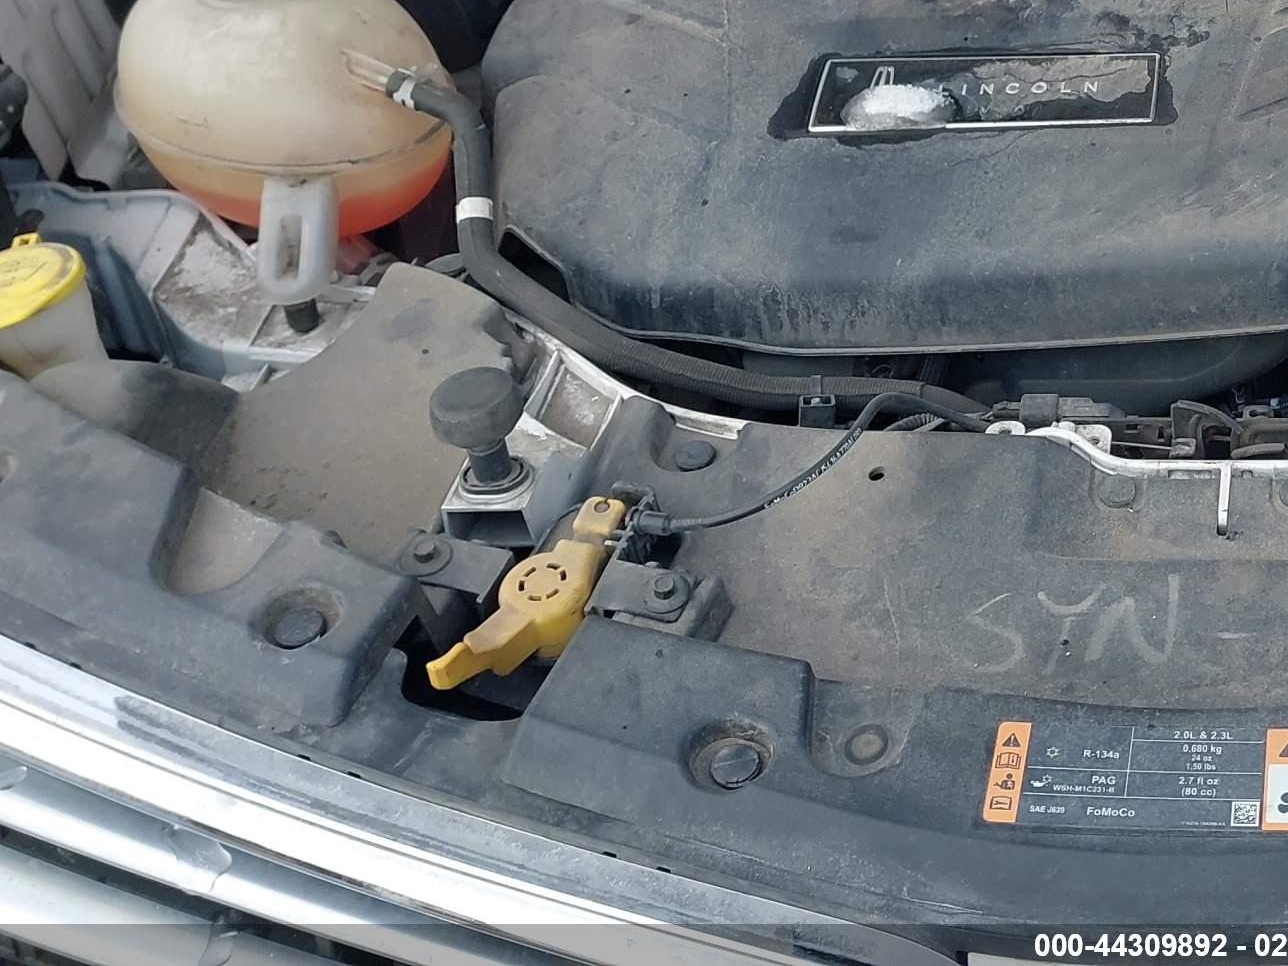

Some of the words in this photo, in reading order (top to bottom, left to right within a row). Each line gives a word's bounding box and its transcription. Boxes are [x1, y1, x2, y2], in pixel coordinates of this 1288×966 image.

[966, 574, 1179, 673] SYN
[1174, 731, 1197, 739] 2.0L
[1200, 731, 1208, 739] &
[1210, 731, 1234, 740] 2.3L
[1083, 749, 1120, 759] R-134a
[1183, 744, 1208, 753] 0.680
[1210, 745, 1222, 755] kg
[1191, 754, 1201, 762] 24
[1204, 763, 1216, 771] lbs
[1091, 775, 1117, 785] PAG
[1178, 777, 1194, 785] 2.7
[1197, 777, 1204, 785] fl
[1181, 787, 1197, 797] (80
[1200, 788, 1216, 797] cc)
[1029, 805, 1046, 813] SAE
[1086, 806, 1136, 817] FoMoCo
